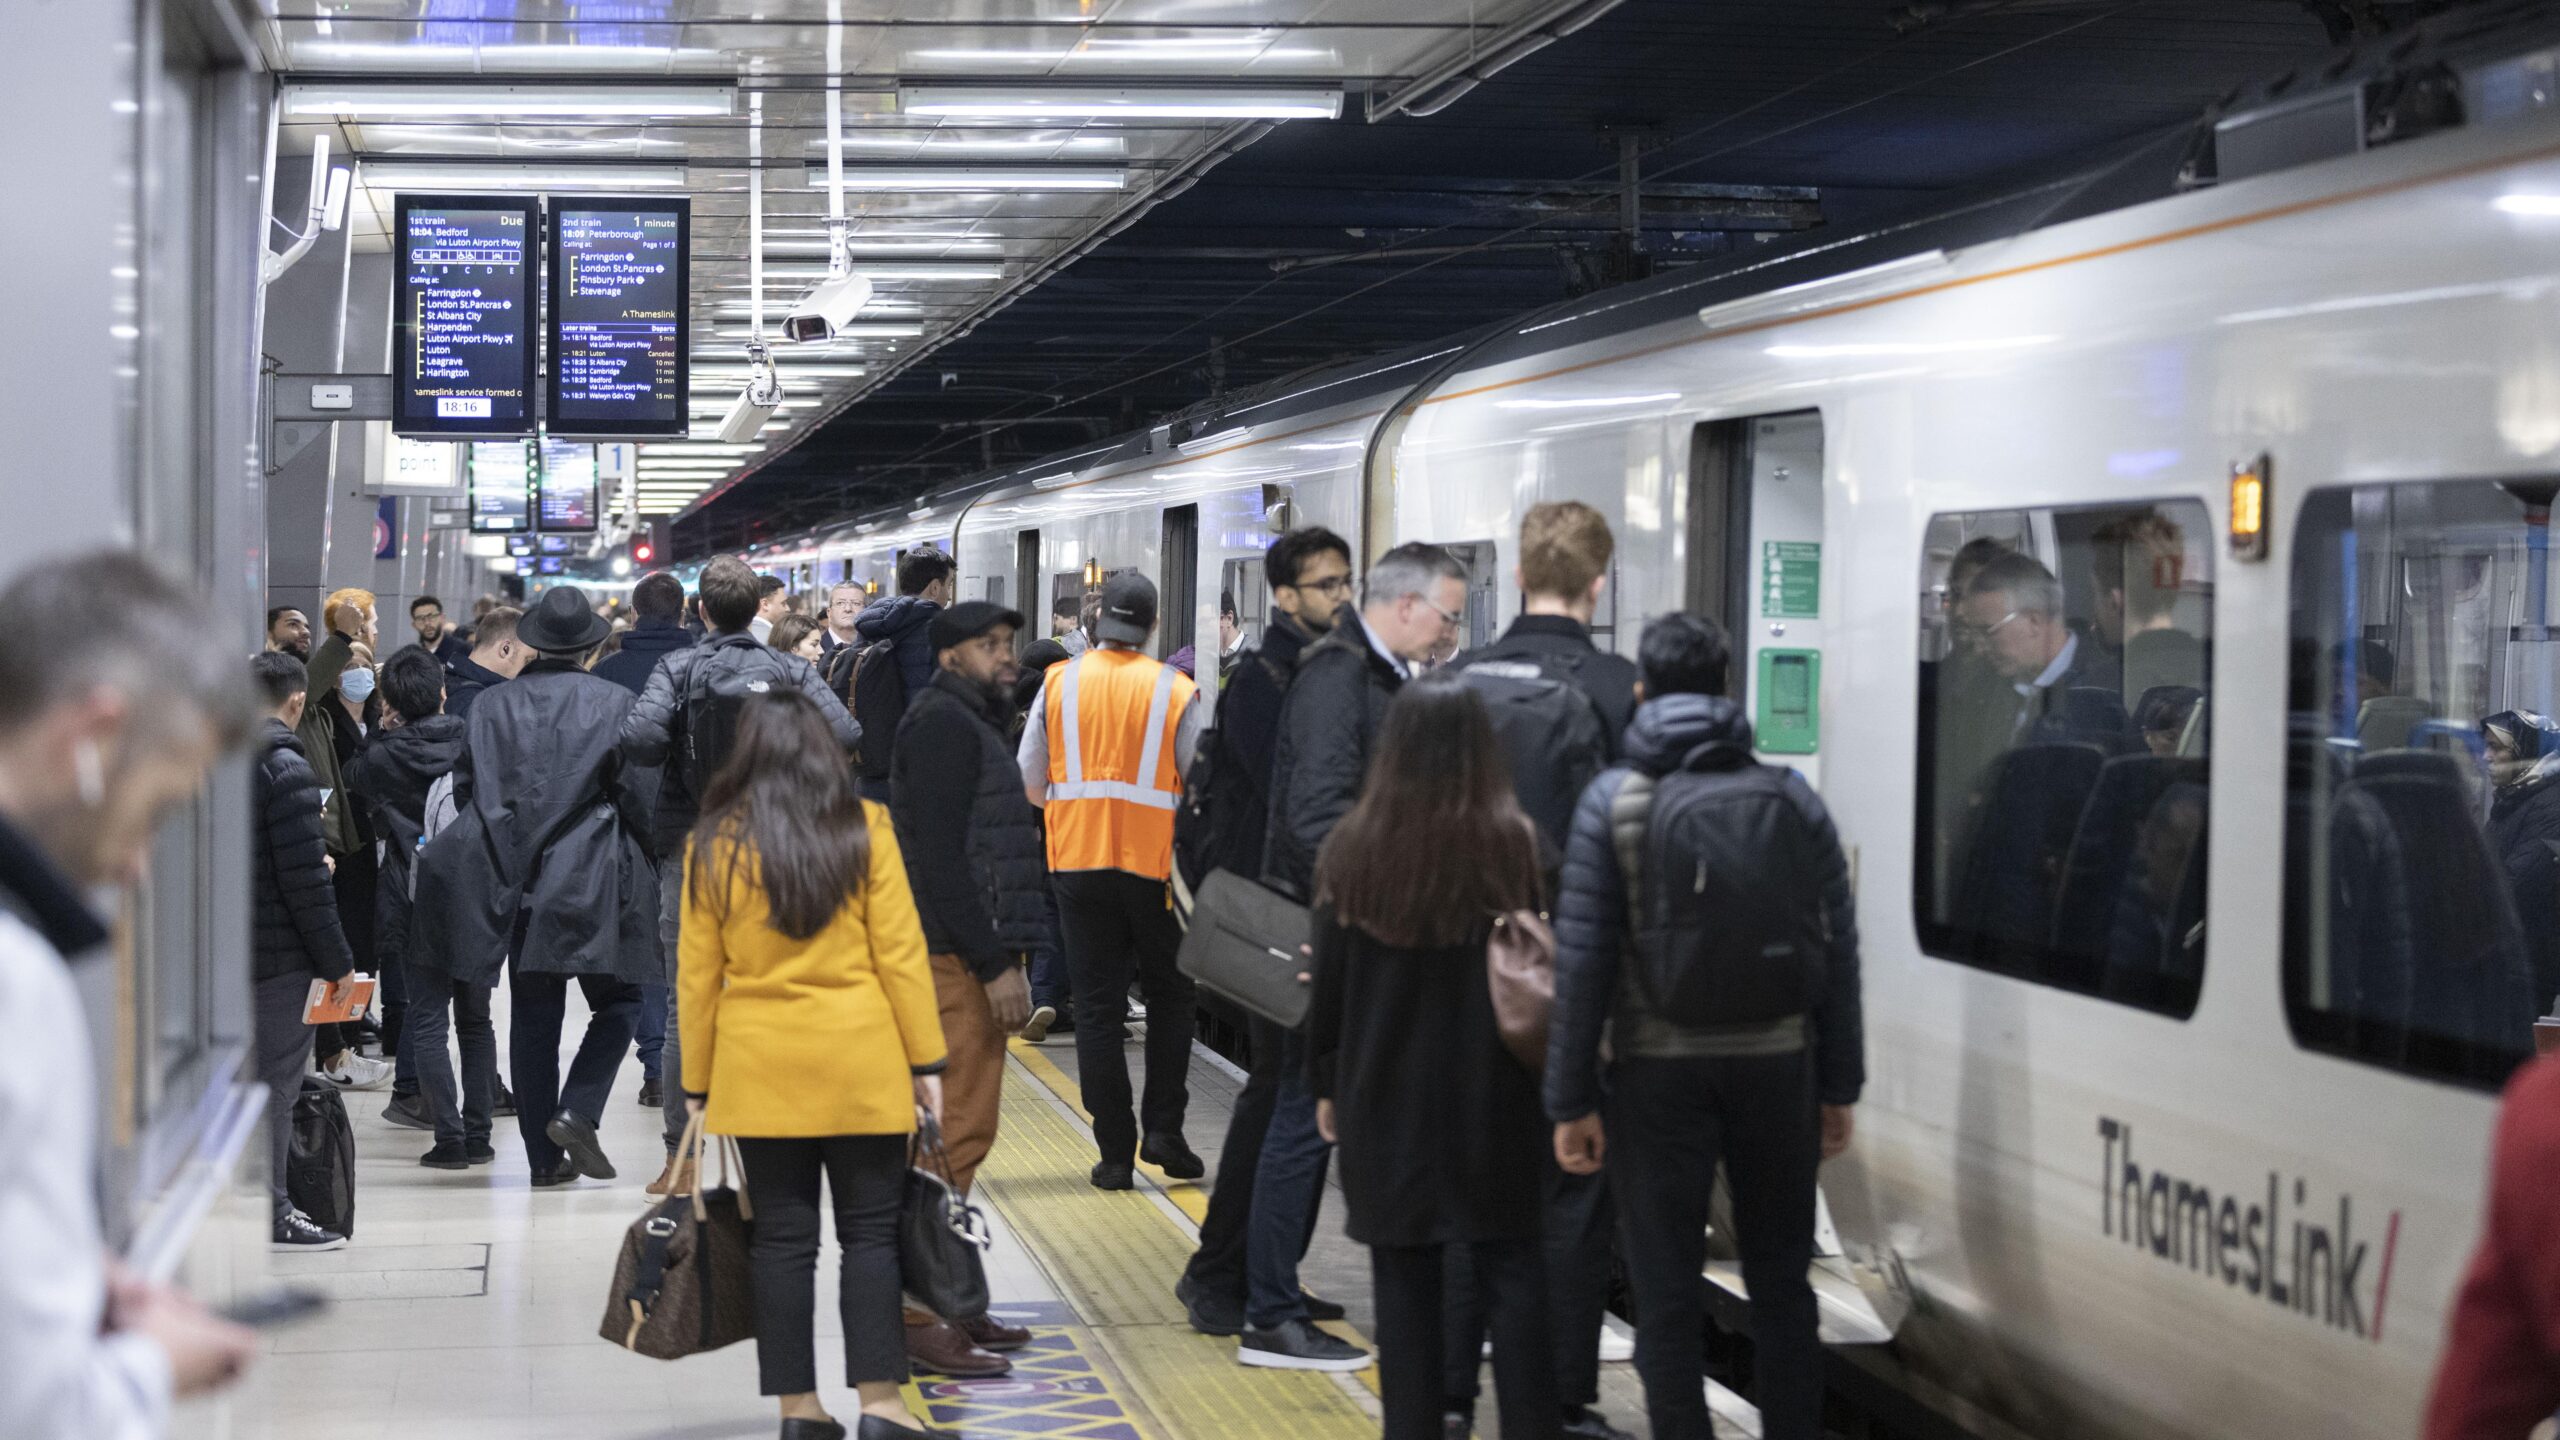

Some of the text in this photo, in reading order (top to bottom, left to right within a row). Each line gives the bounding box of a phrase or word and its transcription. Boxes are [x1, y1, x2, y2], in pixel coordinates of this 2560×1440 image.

[410, 216, 523, 226] 1st train Due
[563, 216, 676, 228] 2nd train 1 minute
[410, 228, 468, 237] 18:04 Bedford
[563, 230, 644, 240] 18:09 Peterborough
[449, 239, 471, 247] Luton
[472, 239, 500, 248] Airport
[501, 239, 521, 248] Pkwy
[563, 241, 583, 249] Calling
[643, 242, 657, 250] Page
[581, 253, 625, 263] Farringdon
[580, 264, 654, 273] London St.Pancras
[410, 277, 431, 285] Calling
[580, 276, 635, 286] Finsbury Park
[427, 288, 471, 299] Farringdon
[580, 287, 621, 297] Stevenage
[427, 300, 502, 309] London St.Pancras
[427, 312, 482, 322] St Albans City
[630, 310, 676, 319] Thameslink
[427, 323, 472, 333] Harpenden
[651, 325, 676, 333] Departs
[427, 334, 504, 345] Luton Airport Pkwy
[427, 346, 450, 354] Luton
[427, 357, 463, 367] Leagrave
[427, 369, 470, 379] Harlington
[589, 368, 620, 376] Cambridge
[455, 388, 484, 397] service
[485, 388, 515, 397] formed
[625, 393, 636, 401] City
[445, 402, 477, 412] 18:16
[612, 445, 622, 470] 1
[2099, 1114, 2366, 1338] ThamesLink
